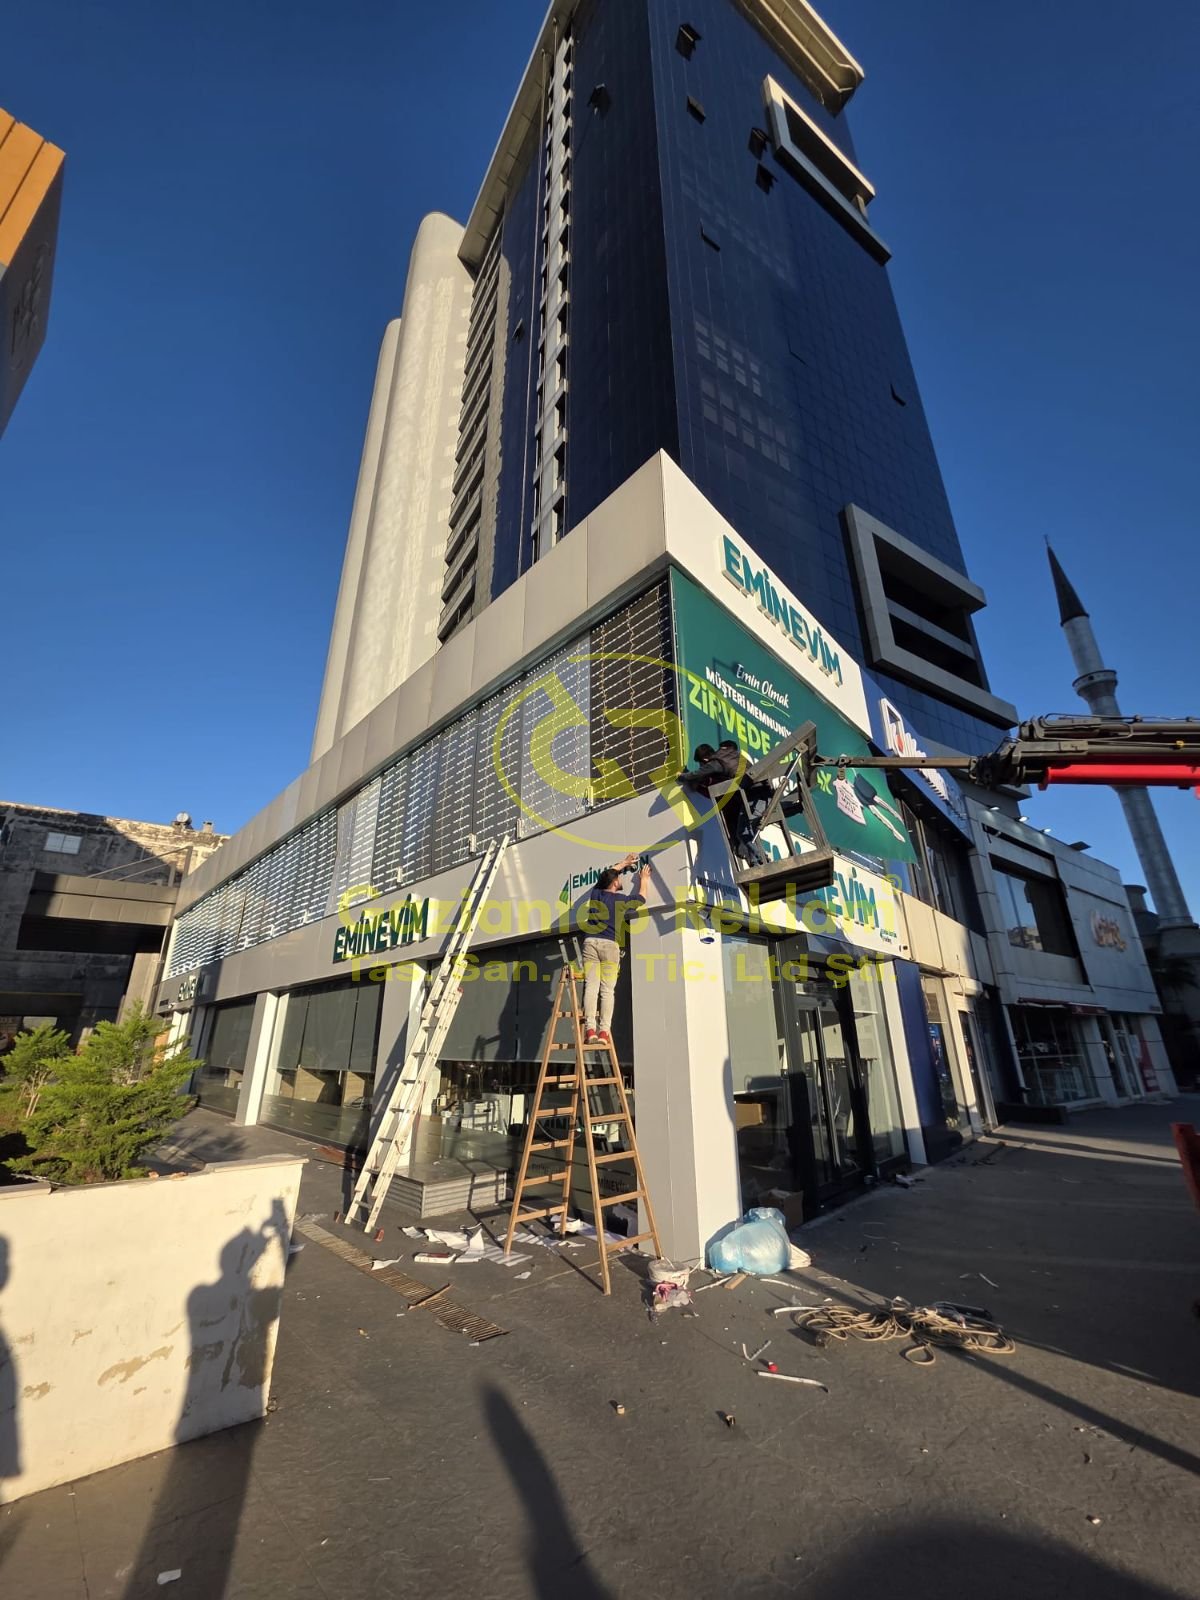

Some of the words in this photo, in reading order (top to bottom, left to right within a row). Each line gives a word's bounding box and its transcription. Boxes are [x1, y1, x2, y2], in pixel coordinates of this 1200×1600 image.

[722, 534, 844, 687] EMİNEVİM
[736, 663, 760, 689] Emin
[761, 680, 790, 709] Olmak
[333, 893, 431, 965] EMİNEVİM
